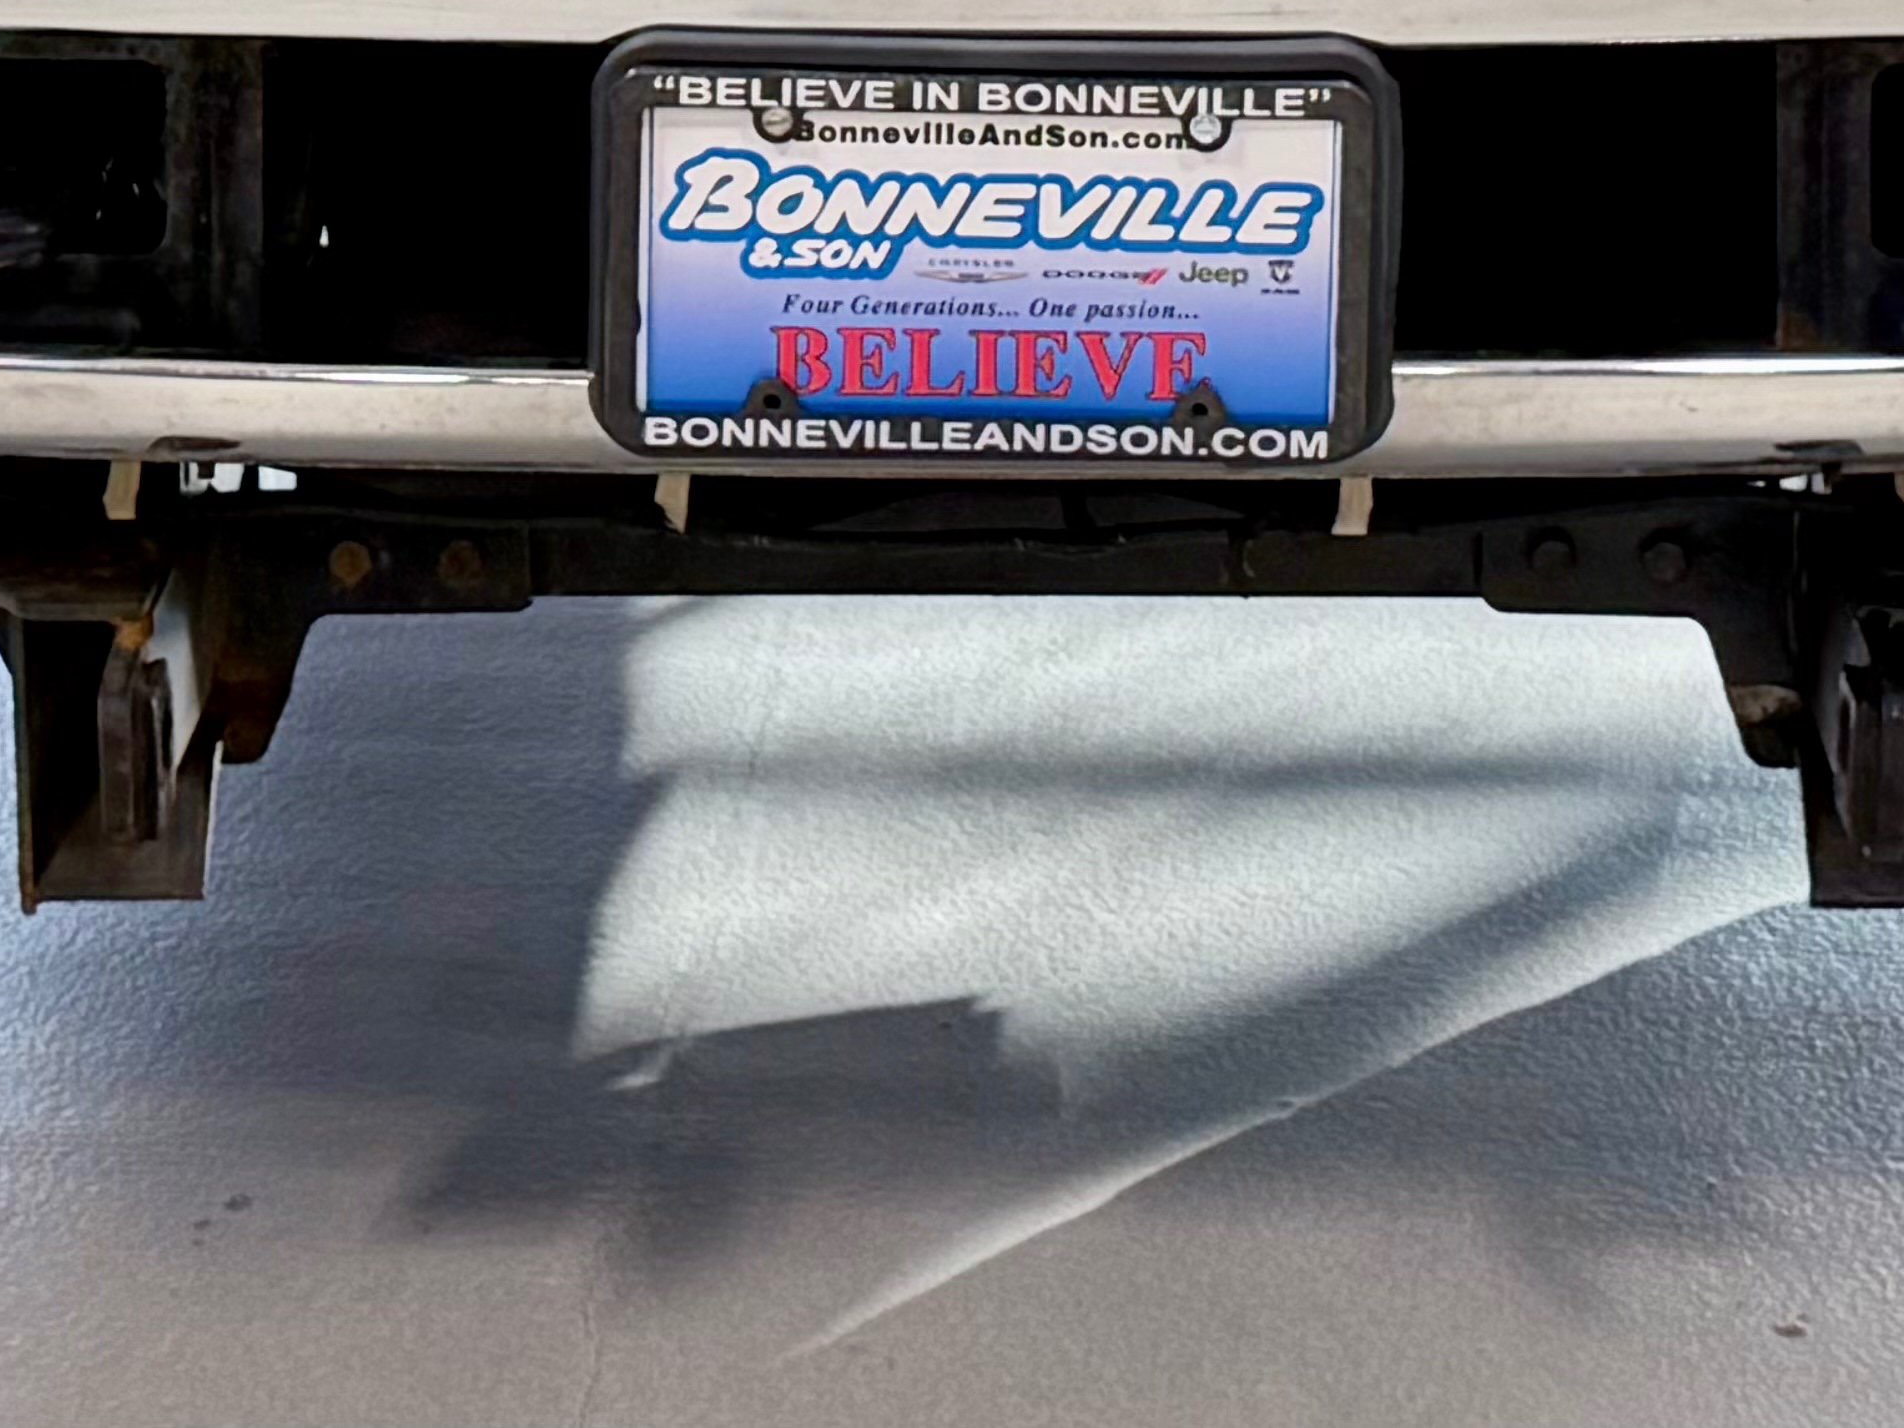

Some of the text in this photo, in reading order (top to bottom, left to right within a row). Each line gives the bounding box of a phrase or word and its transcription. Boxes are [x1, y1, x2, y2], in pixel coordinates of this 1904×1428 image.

[911, 81, 960, 112] IN
[666, 153, 1316, 247] BONNEVILLE
[1178, 260, 1250, 287] Jeep
[782, 293, 844, 315] Four
[1028, 297, 1084, 319] One
[769, 325, 1211, 402] BELIEVE
[642, 415, 1329, 459] BONNEVILLEANDSON.COM
